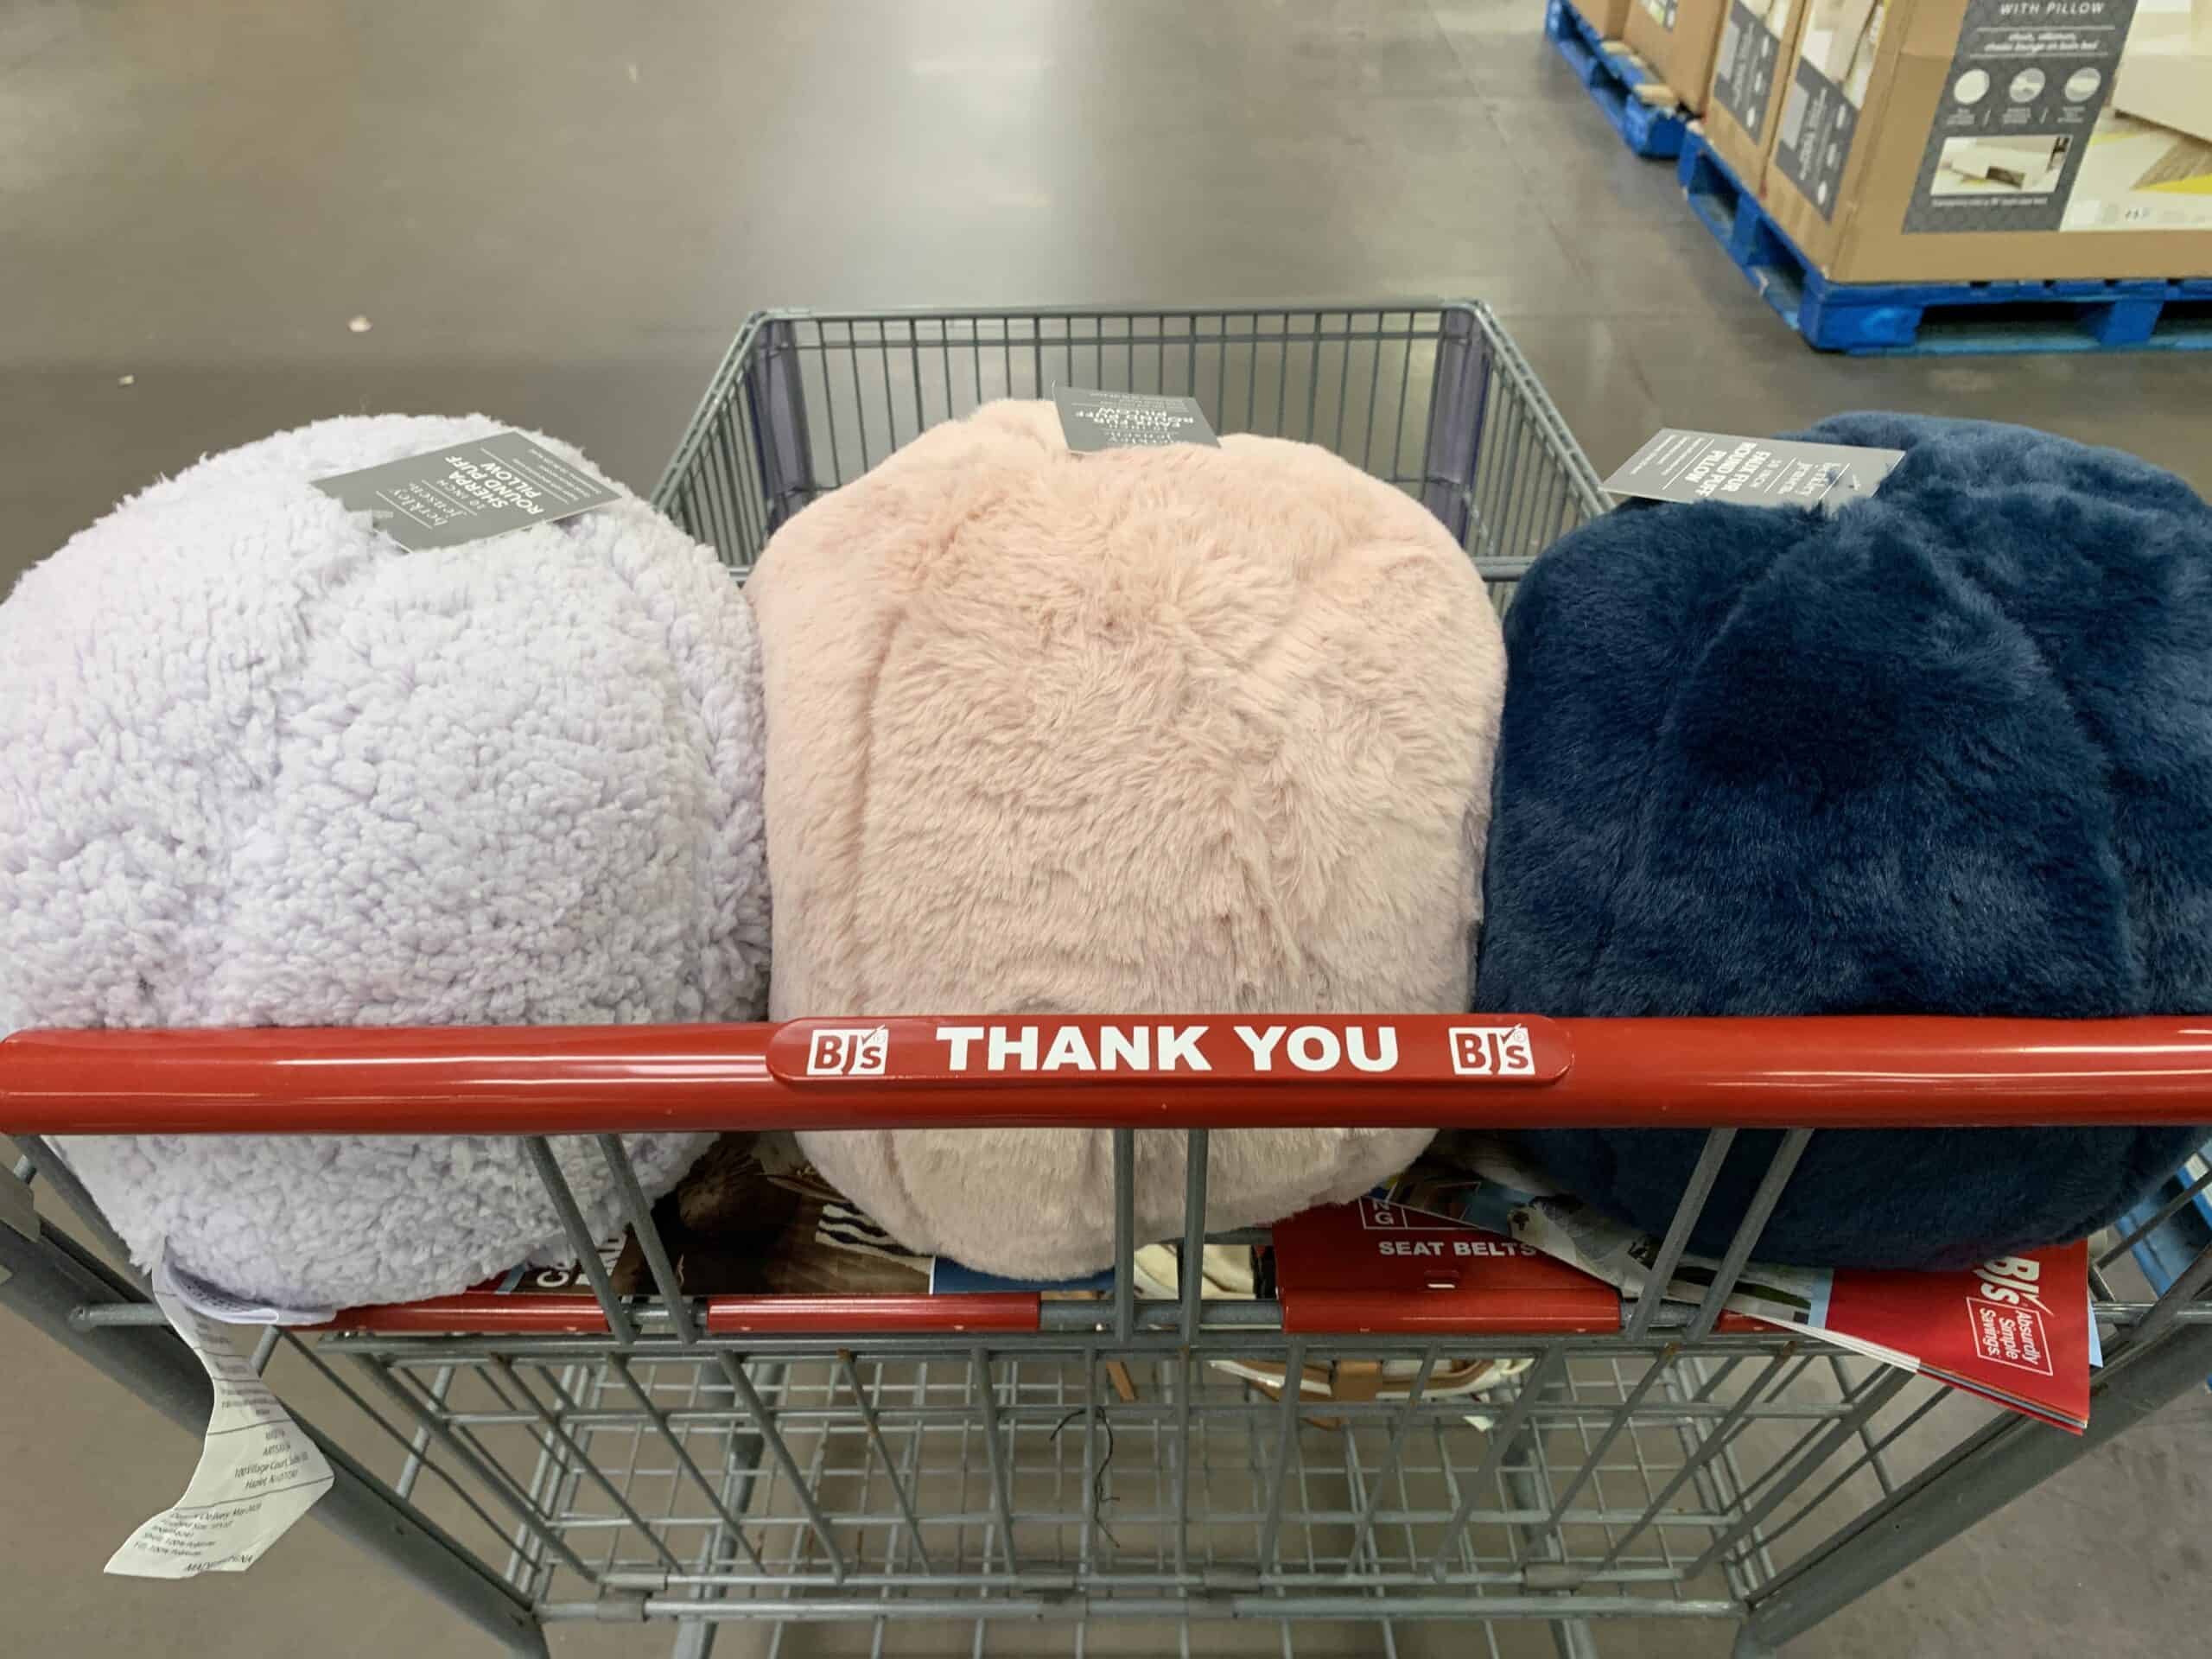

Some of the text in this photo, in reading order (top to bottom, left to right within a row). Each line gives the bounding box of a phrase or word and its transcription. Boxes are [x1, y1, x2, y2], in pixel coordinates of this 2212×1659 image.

[1999, 2, 2105, 15] WITH PILLOW
[444, 455, 488, 480] PUFF
[480, 462, 543, 499] PILLOW
[1684, 449, 1728, 483] PILLOW
[1695, 442, 1758, 497] ROUND PUFF
[1720, 450, 1772, 493] FAUX FUR
[448, 470, 509, 508] SHERPA
[485, 480, 544, 515] ROUND
[936, 1026, 1212, 1071] THANK
[1233, 1026, 1399, 1072] YOU
[1378, 1241, 1536, 1256] SEAT BELTS
[1980, 1307, 2001, 1356] Savings
[1999, 1318, 2021, 1359] Simple
[2015, 1310, 2041, 1364] Absurdly
